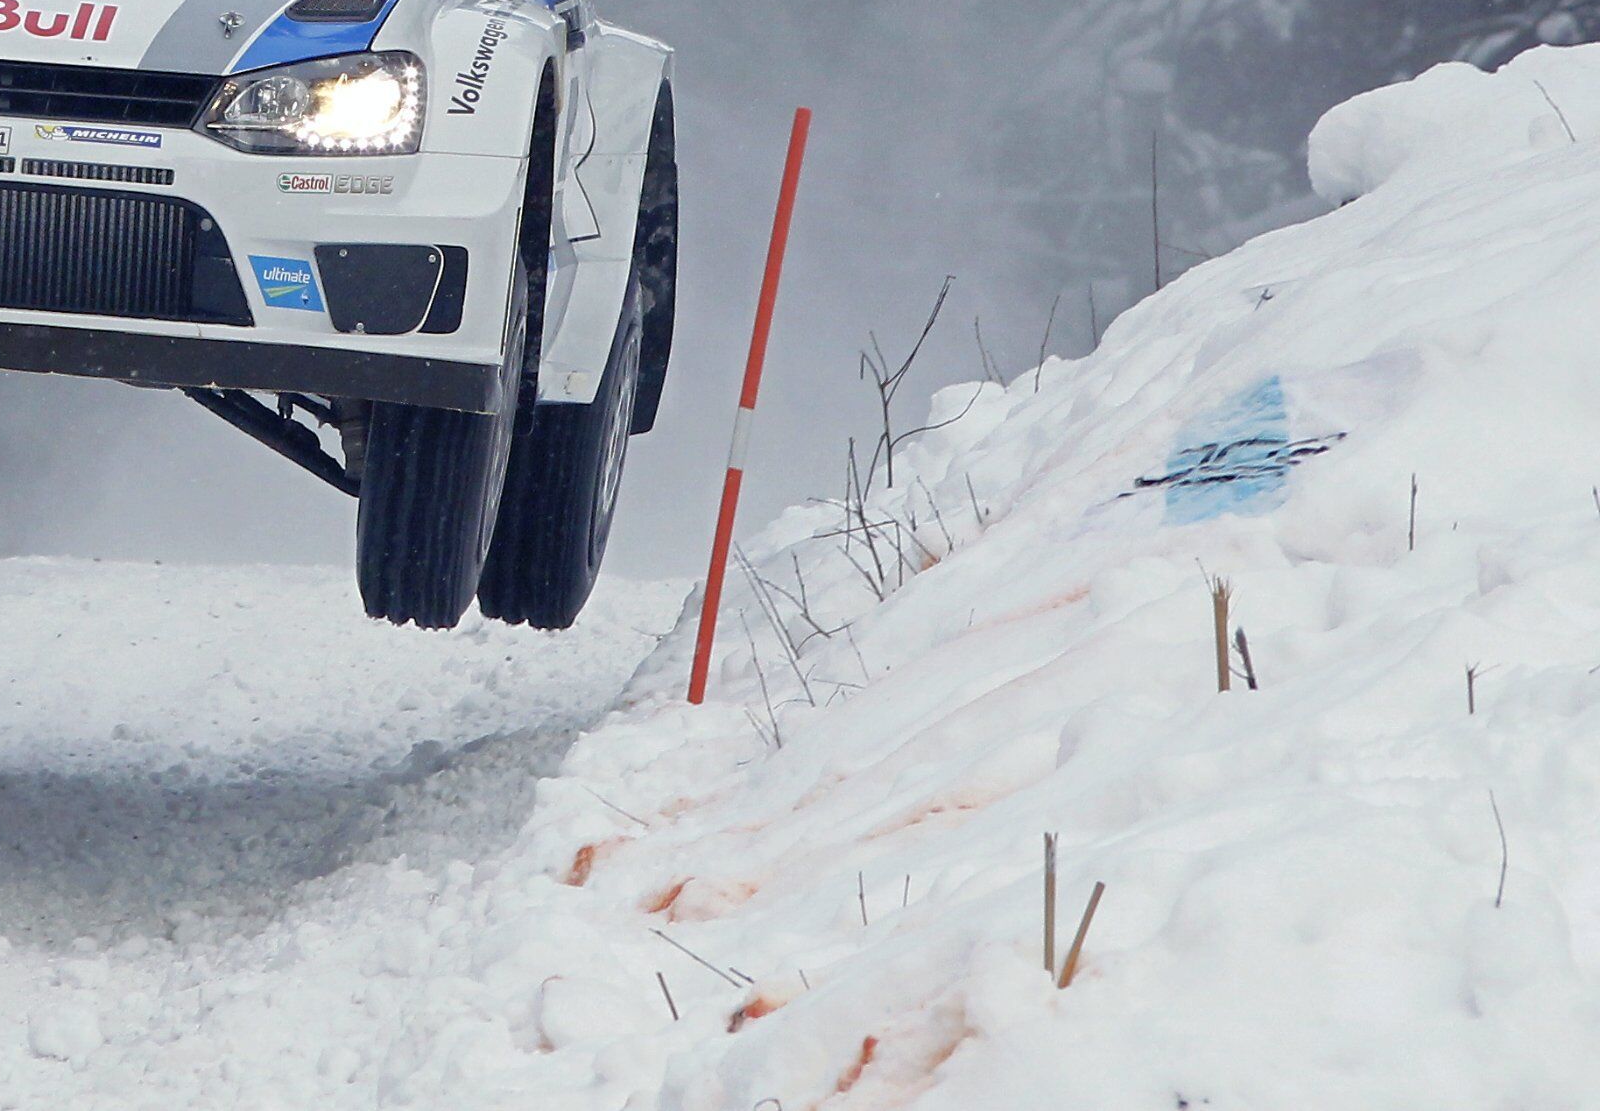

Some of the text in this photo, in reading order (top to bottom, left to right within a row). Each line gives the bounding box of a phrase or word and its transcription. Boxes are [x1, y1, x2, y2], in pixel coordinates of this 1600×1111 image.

[446, 18, 509, 115] Volkswagen
[71, 129, 160, 144] MICHELIN
[290, 174, 395, 195] Castrol EDGE
[262, 266, 312, 284] ultimate
